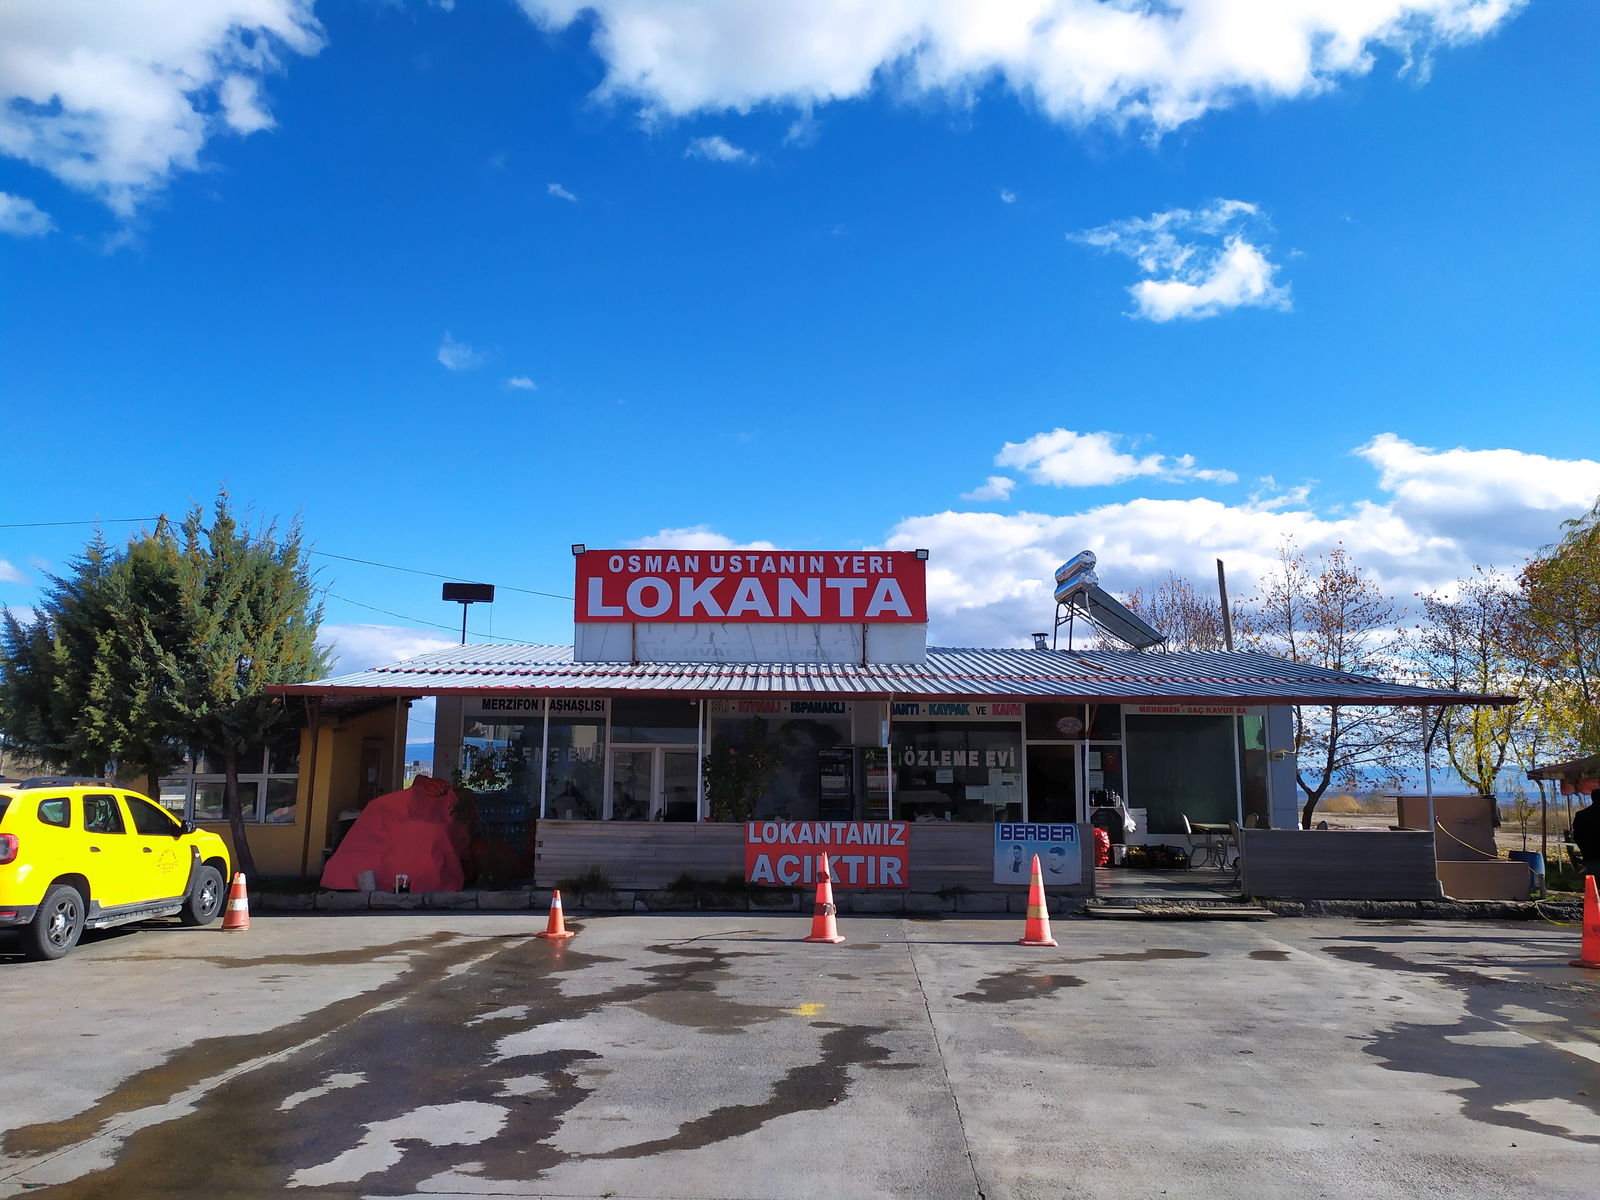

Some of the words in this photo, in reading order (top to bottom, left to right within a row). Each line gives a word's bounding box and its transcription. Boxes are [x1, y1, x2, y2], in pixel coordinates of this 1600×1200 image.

[608, 555, 700, 573] OSMAN
[710, 555, 824, 573] USTANIN
[587, 576, 913, 618] LOKANTA
[481, 697, 539, 711] MERZİFON
[542, 698, 605, 713] AŞHAŞLISI
[975, 705, 987, 715] VE
[1138, 705, 1181, 714] MENEMEN
[986, 747, 1016, 767] EVİ
[748, 822, 906, 846] LOKANTAMIZ
[999, 823, 1076, 843] BERBER
